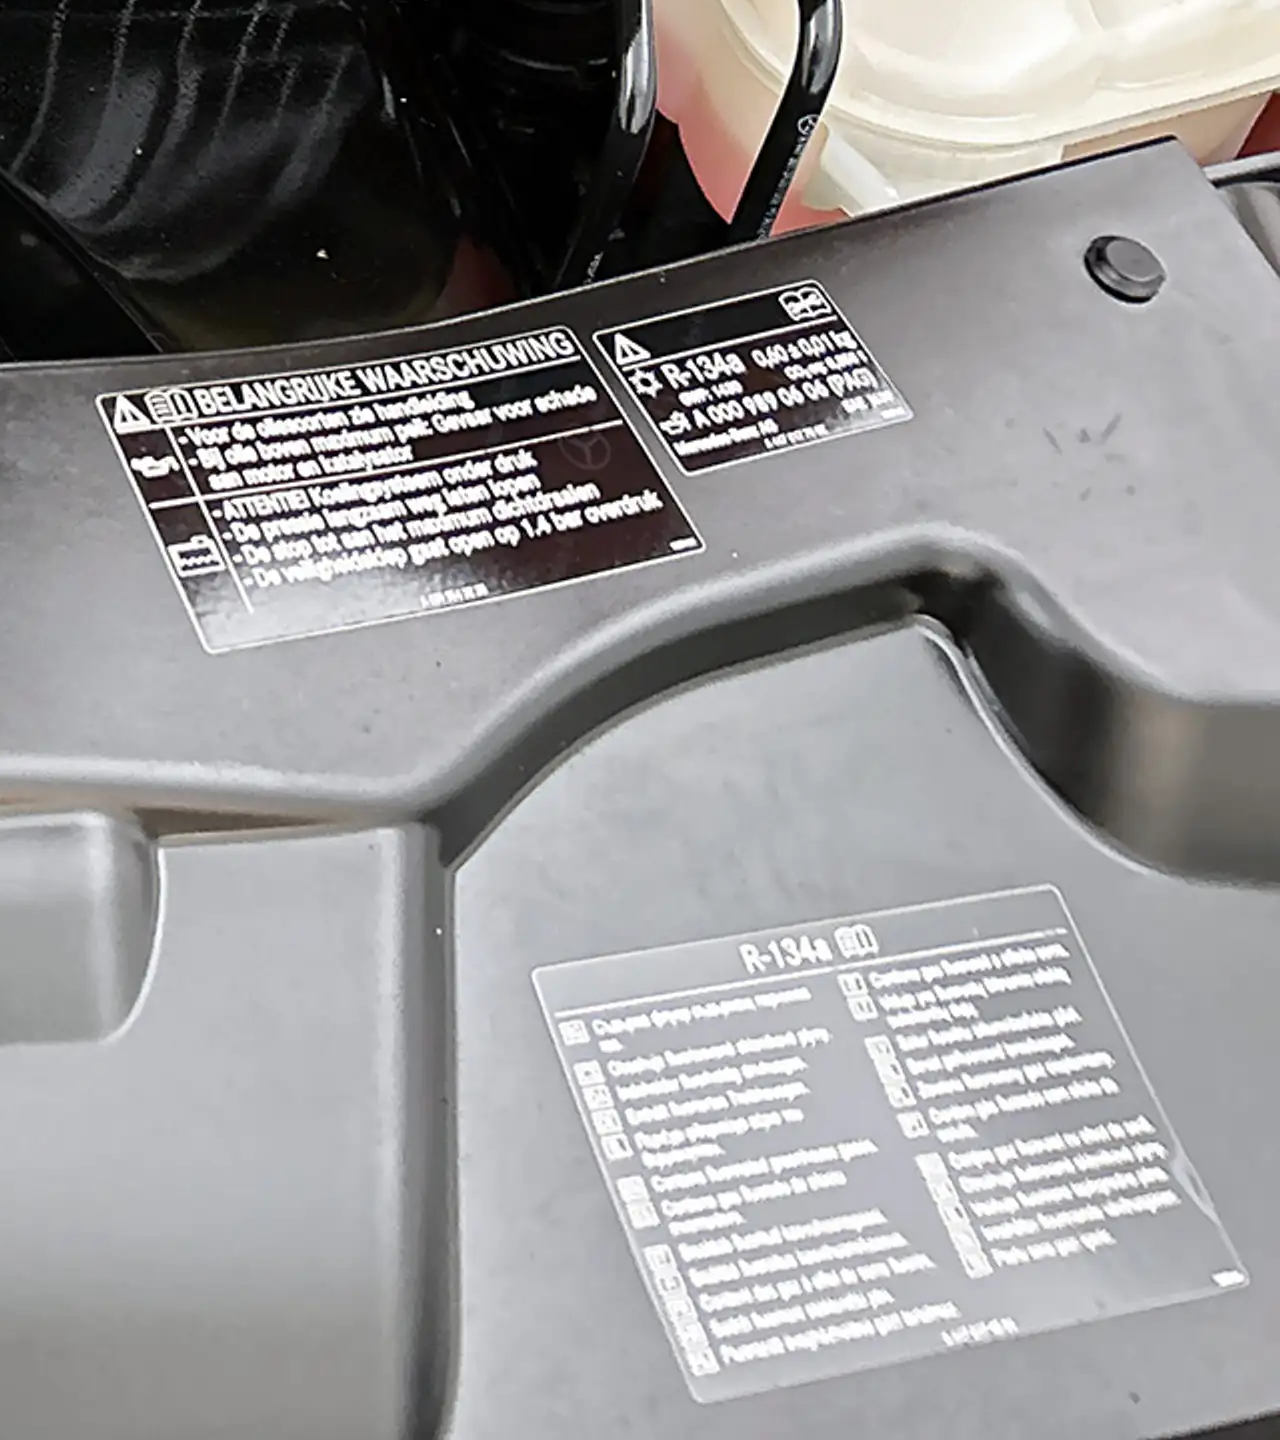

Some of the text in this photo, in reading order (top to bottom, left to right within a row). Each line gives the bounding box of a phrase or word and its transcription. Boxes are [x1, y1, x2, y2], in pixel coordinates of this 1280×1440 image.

[197, 332, 576, 416] BELANGRIJKE WAARSCHUWING
[660, 352, 746, 389] R-134a
[752, 344, 789, 368] 0,60
[797, 334, 834, 357] 0,01
[829, 331, 857, 349] kg
[693, 368, 878, 428] A 000 989 06 06 (PAG)
[185, 427, 230, 449] Voor
[232, 422, 256, 440] de
[196, 447, 226, 470] Bij
[224, 444, 258, 465] olie
[255, 439, 311, 460] boven
[431, 407, 492, 432] Gevaar
[492, 399, 532, 420] voor
[534, 385, 596, 412] schade
[208, 471, 243, 490] aan
[242, 463, 295, 485] motor
[296, 460, 322, 477] en
[443, 460, 493, 484] onder
[495, 449, 537, 473] druk
[230, 522, 261, 542] De
[489, 474, 541, 499] lopen
[240, 544, 272, 568] De
[269, 539, 318, 567] stop
[310, 532, 342, 556] tot
[340, 529, 375, 549] aan
[372, 521, 407, 543] het
[252, 565, 280, 588] De
[408, 537, 450, 566] gaat
[448, 531, 495, 556] open
[494, 525, 520, 546] op
[520, 515, 551, 538] 1.4
[549, 510, 583, 530] bar
[585, 490, 663, 523] overdruk
[739, 936, 833, 974] R-134a
